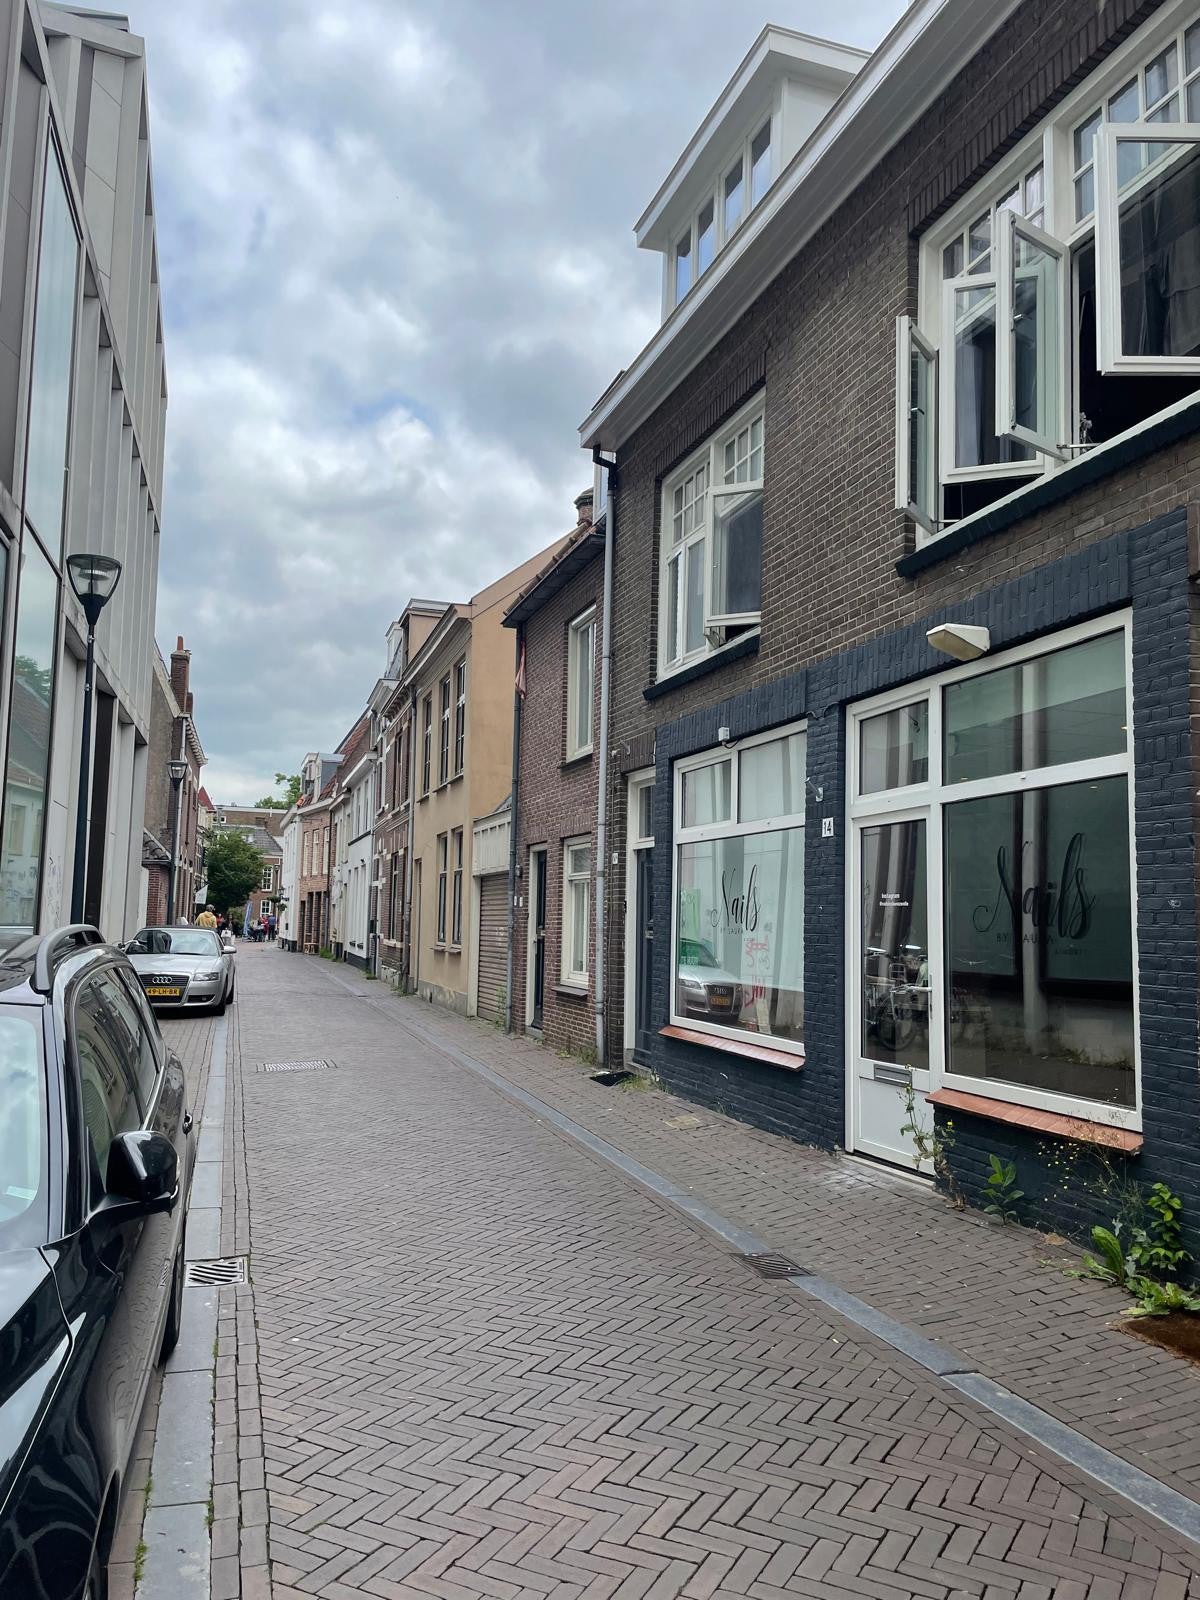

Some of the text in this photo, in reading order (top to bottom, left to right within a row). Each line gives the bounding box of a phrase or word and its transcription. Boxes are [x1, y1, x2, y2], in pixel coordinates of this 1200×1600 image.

[823, 820, 832, 835] 14
[711, 864, 761, 932] Nails
[972, 832, 1097, 940] Nails
